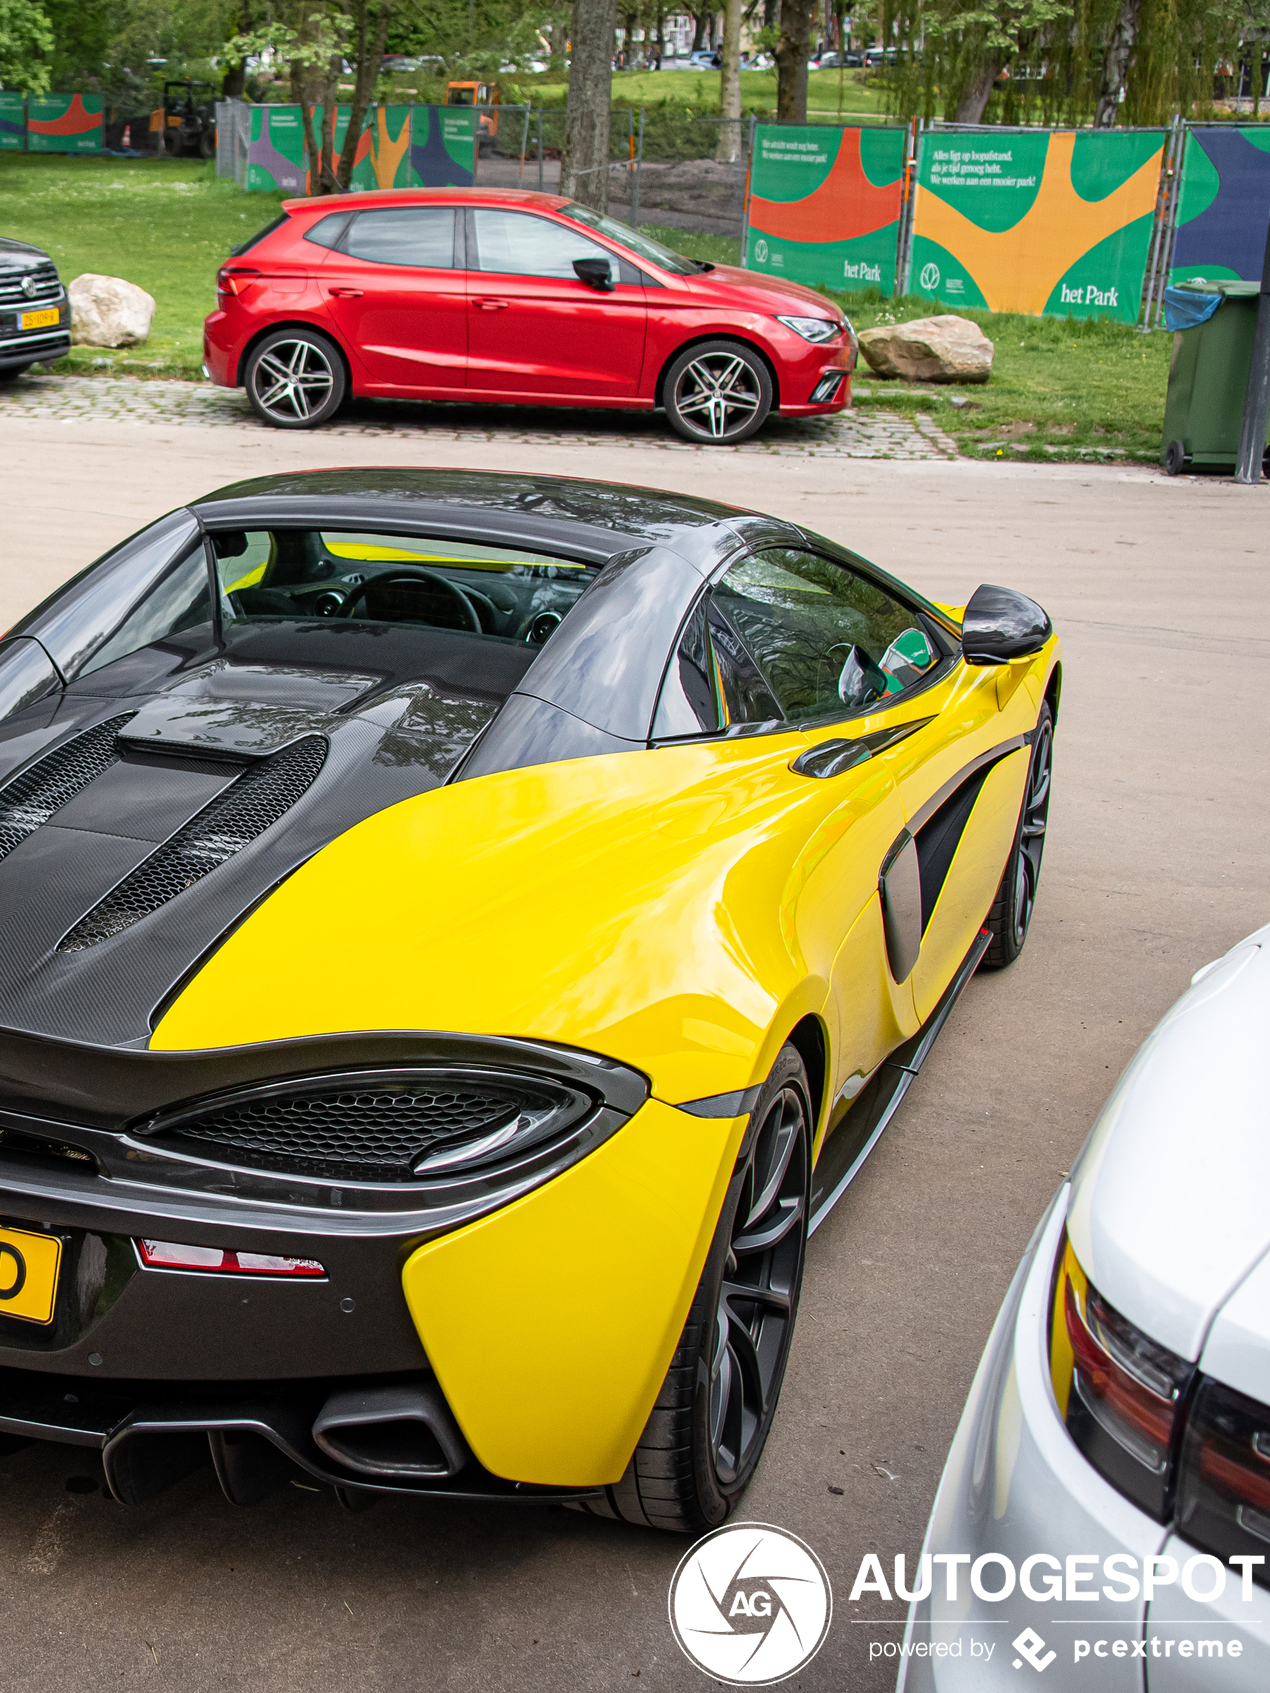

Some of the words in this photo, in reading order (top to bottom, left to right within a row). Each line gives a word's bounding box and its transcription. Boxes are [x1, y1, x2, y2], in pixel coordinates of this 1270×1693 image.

[933, 150, 949, 160] Alles
[950, 150, 961, 162] ligt
[962, 152, 971, 162] op
[931, 162, 941, 173] als
[941, 163, 948, 174] je
[949, 162, 960, 174] tijd
[961, 165, 984, 175] genoeg
[985, 163, 1002, 173] hebt.
[931, 174, 941, 184] We
[942, 175, 965, 185] werken
[992, 176, 1016, 186] mooier
[1016, 176, 1036, 188] park!
[844, 260, 859, 279] het
[859, 262, 881, 281] Park
[1060, 283, 1084, 304] het
[1086, 285, 1119, 306] Park
